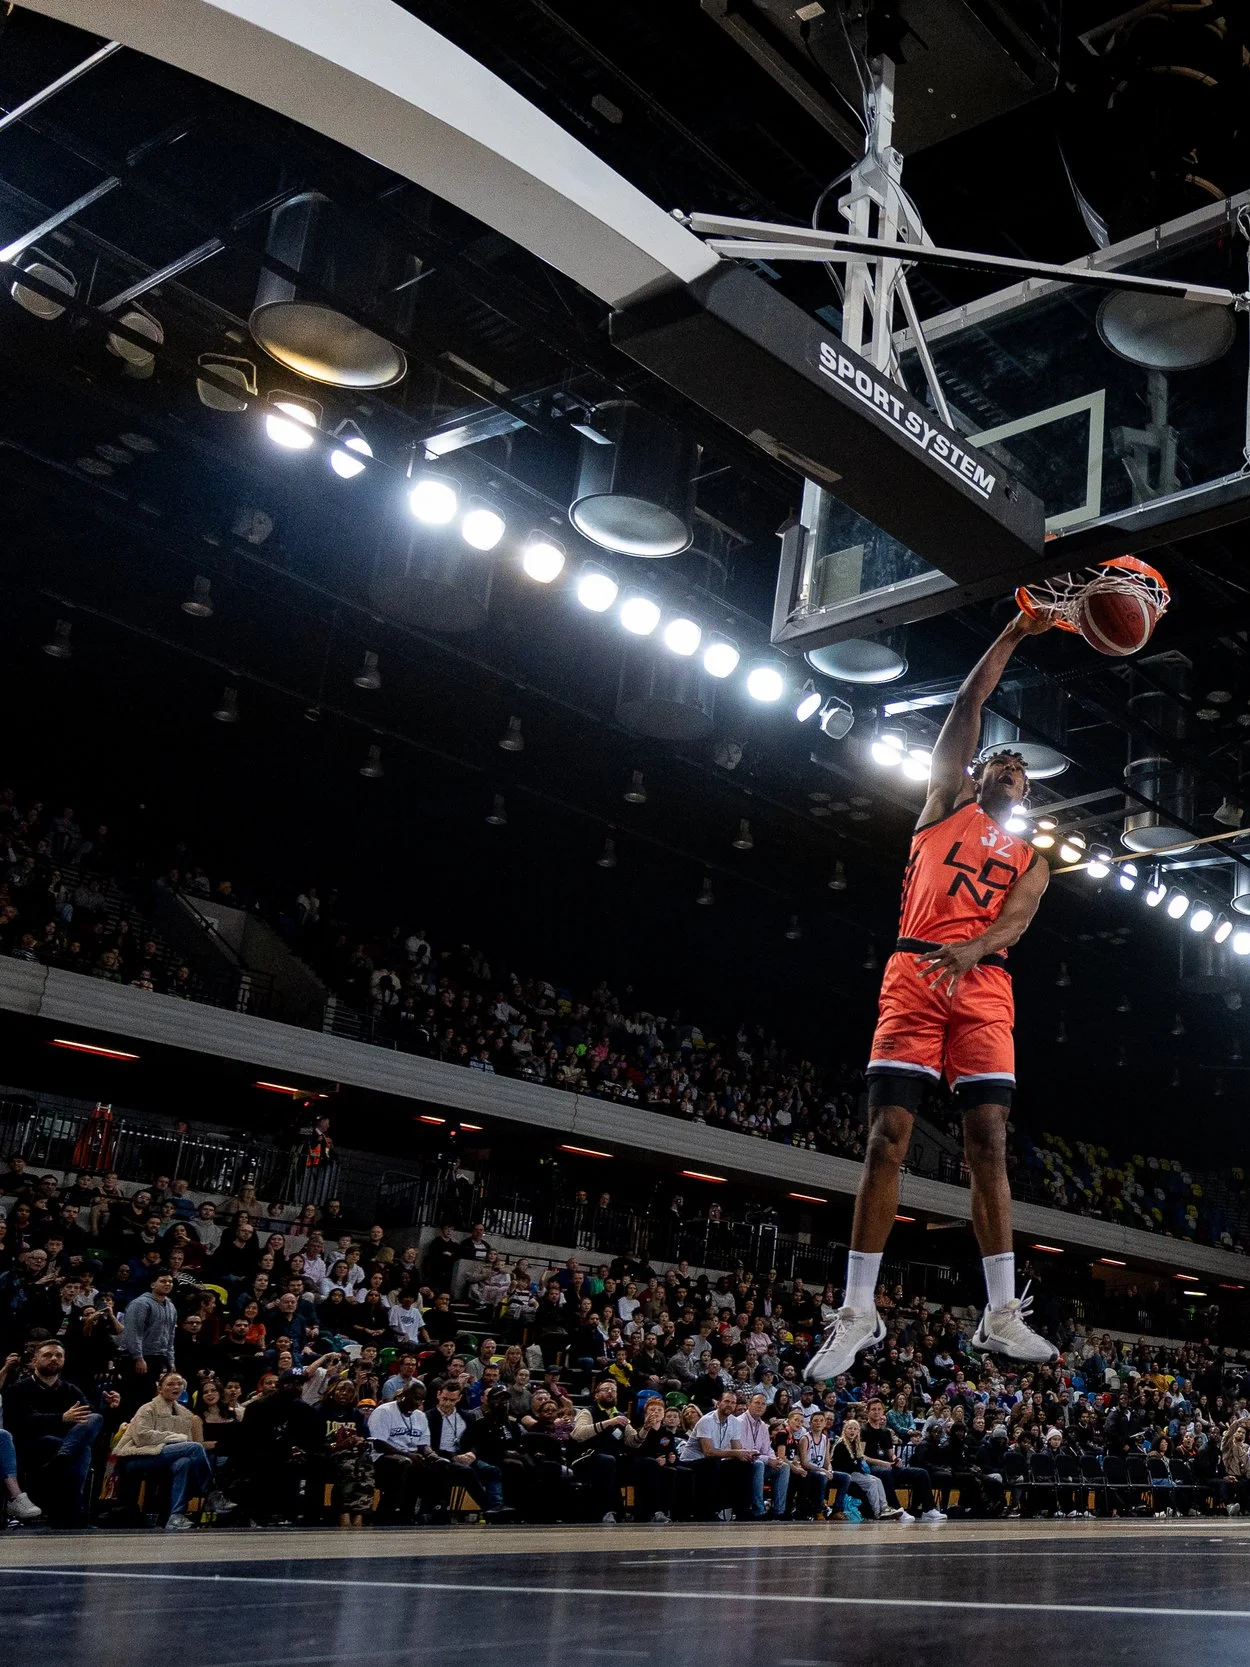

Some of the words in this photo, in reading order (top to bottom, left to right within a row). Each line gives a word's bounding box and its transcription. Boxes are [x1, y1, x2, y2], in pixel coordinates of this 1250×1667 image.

[819, 341, 905, 421] SPORT
[904, 411, 996, 494] SYSTEM
[980, 825, 1015, 858] 32
